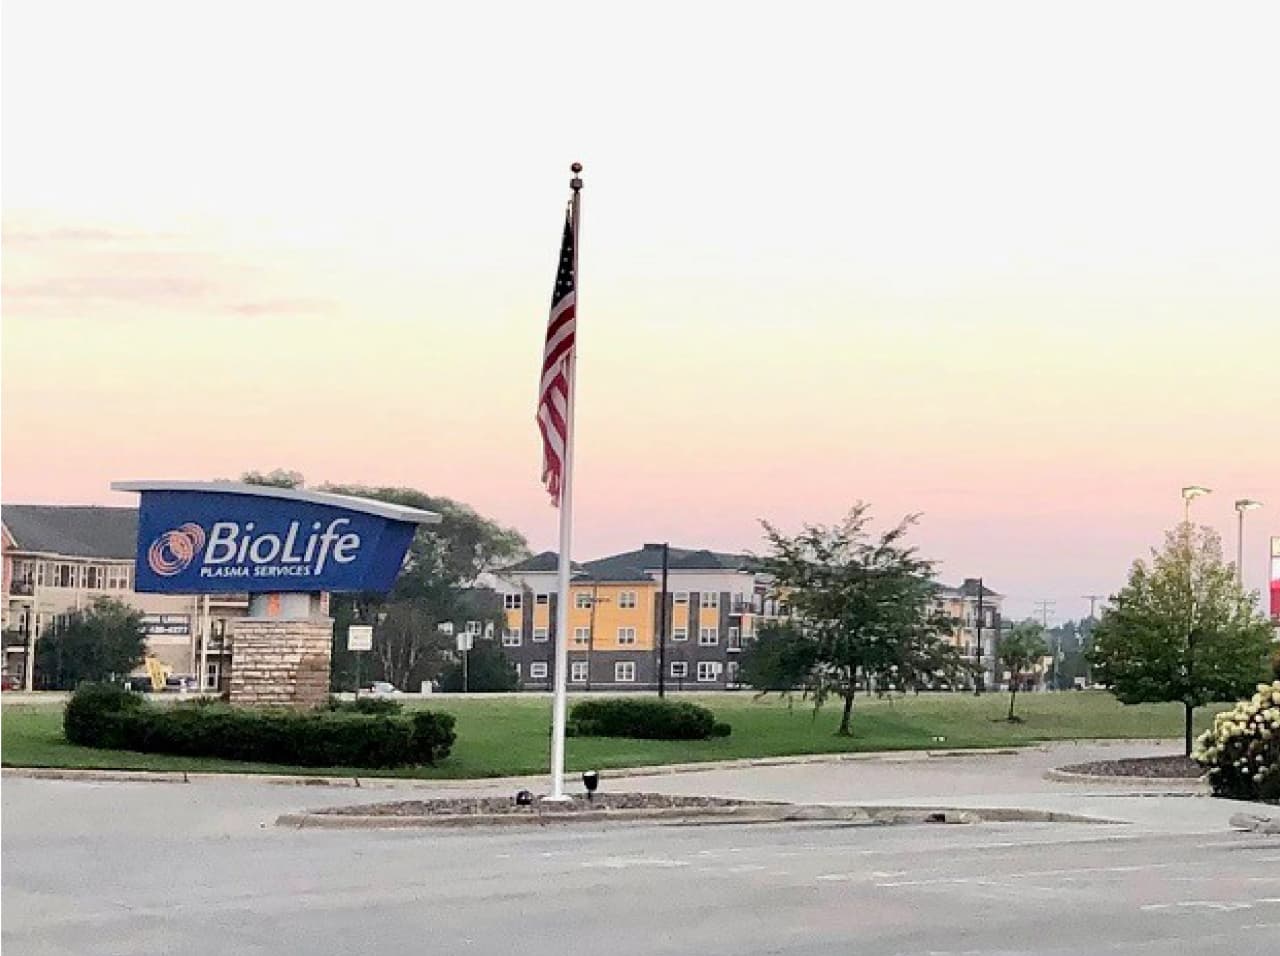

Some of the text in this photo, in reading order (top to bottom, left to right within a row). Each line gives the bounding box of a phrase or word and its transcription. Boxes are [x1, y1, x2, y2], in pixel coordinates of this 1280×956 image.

[204, 518, 361, 576] BioLife
[200, 564, 311, 578] PLASMA SERVICES
